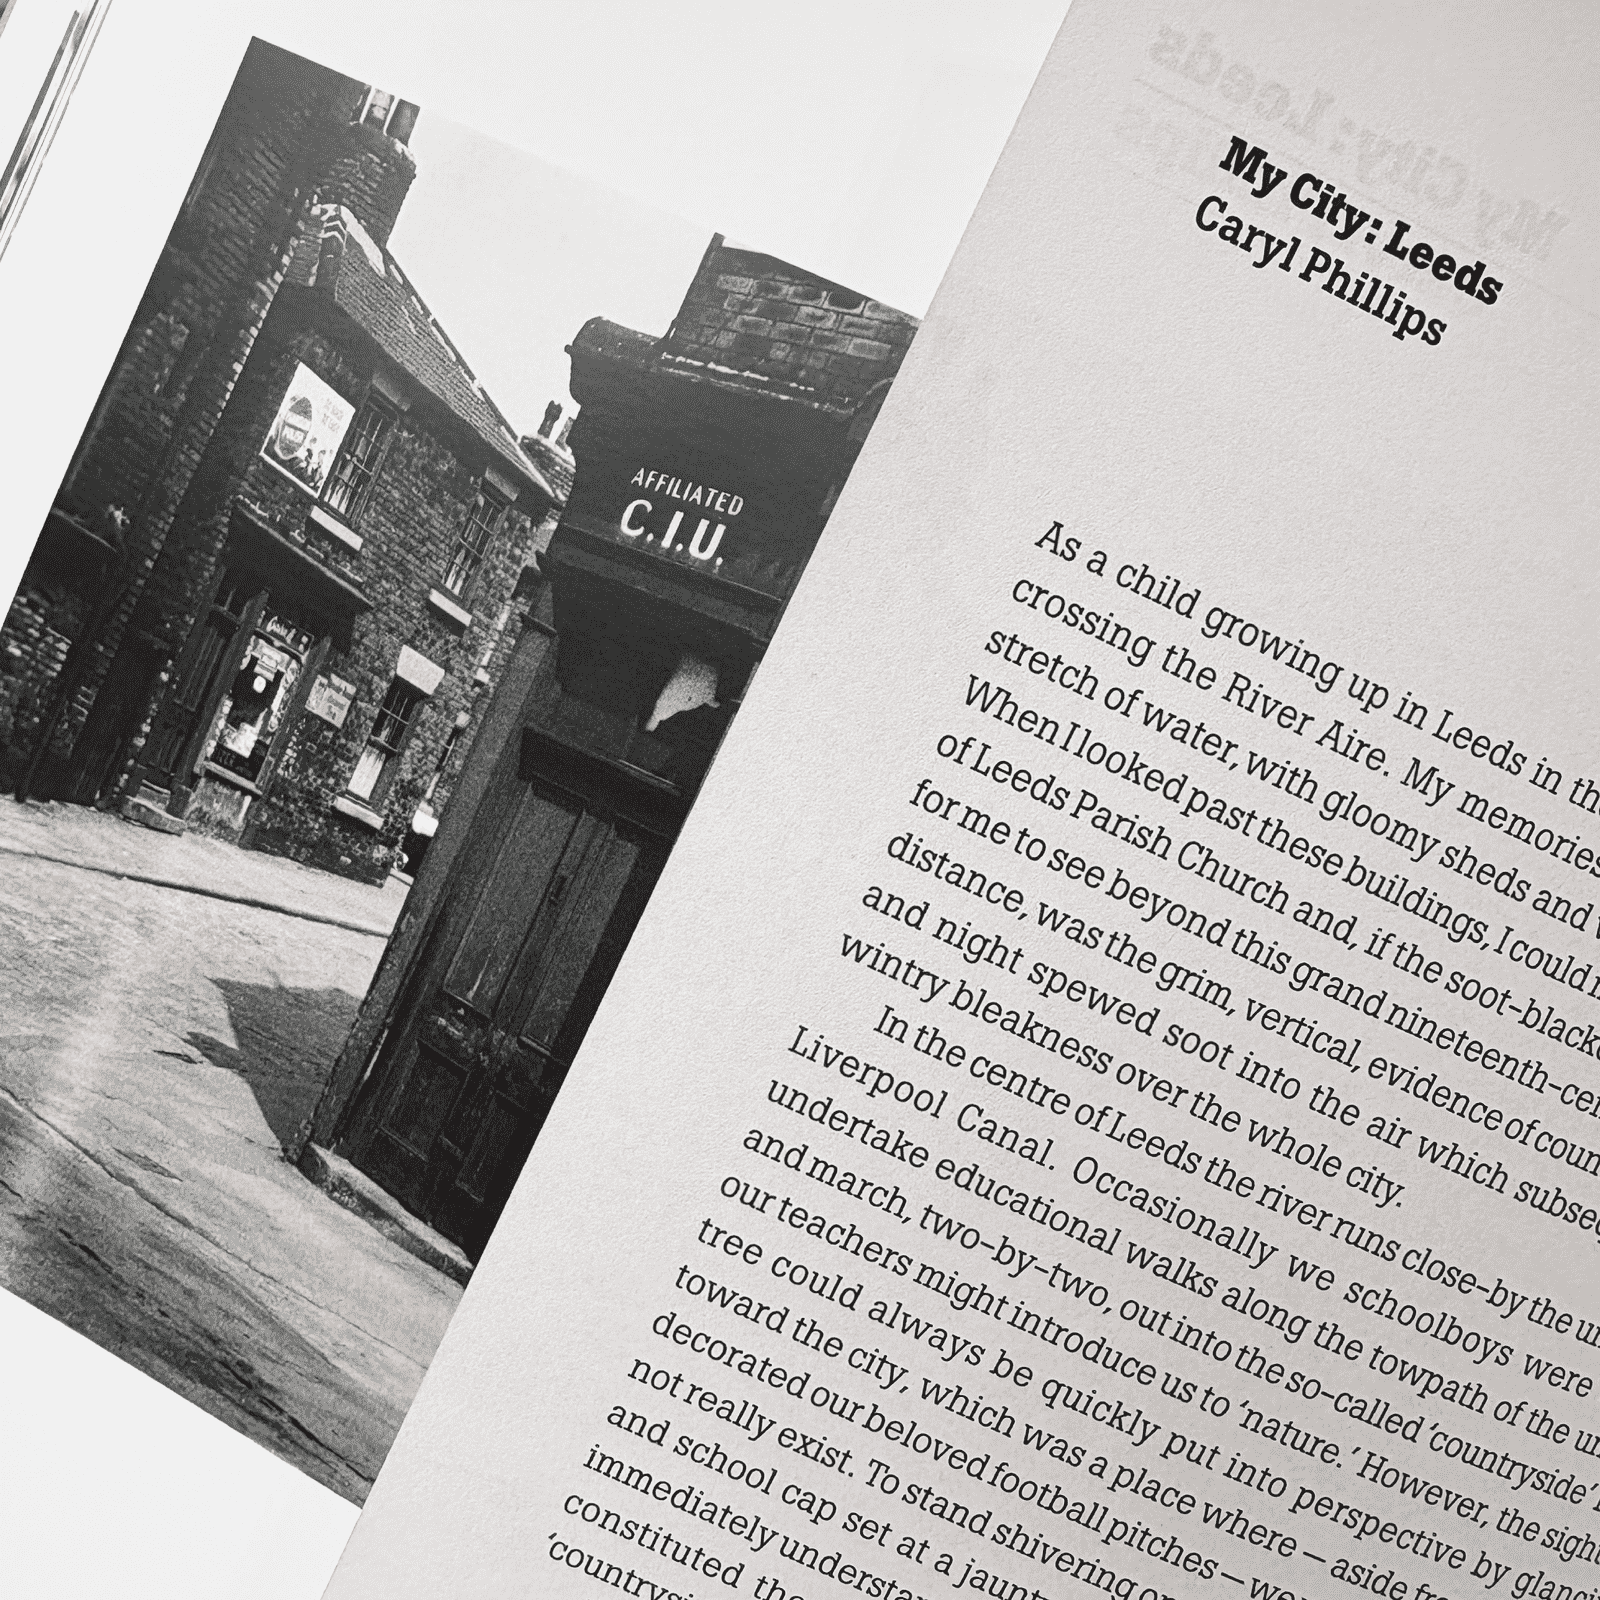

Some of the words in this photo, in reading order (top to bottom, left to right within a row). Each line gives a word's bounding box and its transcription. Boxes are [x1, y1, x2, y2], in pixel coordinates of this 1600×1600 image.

[1196, 196, 1301, 272] Caryl
[1298, 247, 1447, 345] Phillips
[1219, 136, 1288, 198] My
[1290, 173, 1383, 244] City:
[1383, 220, 1503, 305] Leeds
[620, 499, 727, 566] C.I.U.
[630, 467, 744, 516] AFFILIATED
[984, 631, 1098, 700] stretch
[1104, 687, 1144, 717] of
[1143, 702, 1239, 770] water,
[1247, 751, 1318, 804] with
[1319, 791, 1441, 862] gloomy
[1438, 845, 1531, 902] sheds
[1532, 890, 1594, 932] and
[1013, 580, 1157, 667] crossing
[1162, 645, 1216, 690] the
[1221, 672, 1315, 736] River
[1315, 720, 1389, 777] Aire.
[1400, 757, 1455, 807] My
[1034, 521, 1082, 561] As
[1087, 551, 1107, 577] a
[1117, 564, 1201, 619] child
[1201, 607, 1344, 693] growing
[1348, 673, 1389, 714] up
[1393, 691, 1428, 730] in
[1432, 709, 1527, 775] Leeds
[1529, 757, 1562, 795] in
[909, 779, 961, 820] for
[957, 806, 1010, 844] me
[1014, 828, 1046, 861] to
[1047, 849, 1105, 888] see
[1105, 868, 1232, 947] beyond
[1231, 929, 1292, 974] this
[1289, 962, 1388, 1019] grand
[937, 735, 977, 765] of
[970, 743, 1070, 810] Leeds
[1070, 789, 1171, 860] Parish
[1178, 841, 1289, 914] Church
[1293, 902, 1357, 950] and,
[1364, 928, 1396, 960] if
[1393, 942, 1443, 983] the
[966, 674, 1059, 745] When
[1059, 722, 1081, 752] I
[1073, 729, 1188, 803] looked
[1180, 787, 1258, 836] past
[1257, 817, 1343, 875] these
[1342, 855, 1489, 950] buildings,
[1493, 926, 1514, 954] I
[1509, 940, 1593, 992] could
[842, 934, 950, 1003] wintry
[948, 979, 1113, 1074] bleakness
[1116, 1063, 1189, 1108] over
[1190, 1092, 1241, 1132] the
[1249, 1119, 1342, 1177] whole
[1346, 1166, 1405, 1208] city.
[863, 886, 930, 930] and
[932, 917, 1024, 974] night
[1027, 962, 1160, 1036] spewed
[1162, 1024, 1234, 1070] soot
[1236, 1051, 1300, 1099] into
[1309, 1085, 1360, 1126] the
[1367, 1117, 1412, 1149] air
[1418, 1136, 1508, 1194] which
[888, 833, 1027, 920] distance,
[1038, 902, 1104, 949] was
[1105, 932, 1157, 973] the
[1156, 962, 1235, 1016] grim,
[1246, 998, 1361, 1073] vertical,
[1368, 1057, 1503, 1130] evidence
[1505, 1118, 1541, 1145] of
[744, 1130, 809, 1171] and
[806, 1157, 911, 1224] march,
[1120, 1300, 1172, 1336] out
[1169, 1316, 1232, 1361] into
[1235, 1345, 1285, 1384] the
[768, 1080, 929, 1168] undertake
[935, 1159, 1122, 1255] educational
[1127, 1242, 1218, 1298] walks
[1221, 1287, 1312, 1344] along
[1314, 1322, 1363, 1360] the
[1369, 1345, 1488, 1414] towpath
[1494, 1401, 1528, 1426] of
[1525, 1409, 1570, 1444] the
[788, 1025, 948, 1119] Liverpool
[957, 1104, 1054, 1170] Canal.
[1073, 1157, 1279, 1269] Occasionally
[1288, 1255, 1335, 1291] we
[1343, 1282, 1514, 1366] schoolboys
[1524, 1354, 1593, 1397] were
[873, 1005, 908, 1043] In
[914, 1025, 966, 1067] the
[970, 1056, 1070, 1115] centre
[1075, 1104, 1113, 1132] of
[1105, 1111, 1202, 1174] Leeds
[1204, 1157, 1255, 1198] the
[1255, 1185, 1333, 1231] river
[1330, 1217, 1401, 1261] runs
[1528, 1297, 1573, 1334] the
[607, 1406, 670, 1447] and
[673, 1436, 777, 1495] school
[782, 1485, 836, 1525] cap
[842, 1512, 893, 1547] set
[897, 1537, 930, 1564] at
[934, 1554, 953, 1576] a
[628, 1359, 684, 1398] not
[683, 1384, 777, 1441] really
[778, 1428, 853, 1477] exist.
[866, 1458, 899, 1494] To
[902, 1484, 992, 1537] stand
[653, 1312, 811, 1399] decorated
[811, 1387, 865, 1422] our
[862, 1403, 990, 1481] beloved
[987, 1462, 1109, 1533] football
[1101, 1518, 1219, 1579] pitches
[676, 1265, 790, 1334] toward
[792, 1318, 843, 1357] the
[848, 1348, 909, 1393] city,
[921, 1378, 1015, 1438] which
[1023, 1424, 1087, 1467] was
[1089, 1456, 1108, 1479] a
[1107, 1465, 1196, 1514] place
[1203, 1502, 1297, 1557] where
[1331, 1559, 1408, 1600] aside
[698, 1218, 762, 1264] tree
[771, 1257, 863, 1311] could
[868, 1301, 986, 1366] always
[989, 1349, 1033, 1387] be
[1042, 1379, 1161, 1447] quickly
[1159, 1432, 1221, 1470] put
[1223, 1453, 1287, 1497] into
[1288, 1486, 1466, 1569] perspective
[1470, 1550, 1512, 1589] by
[721, 1177, 777, 1213] our
[778, 1197, 913, 1276] teachers
[913, 1263, 1009, 1320] might
[1007, 1301, 1156, 1385] introduce
[1161, 1372, 1198, 1403] us
[1200, 1387, 1230, 1417] to
[1356, 1451, 1489, 1528] However,
[1496, 1507, 1540, 1542] the
[564, 1495, 745, 1588] constituted
[583, 1444, 779, 1552] immediately
